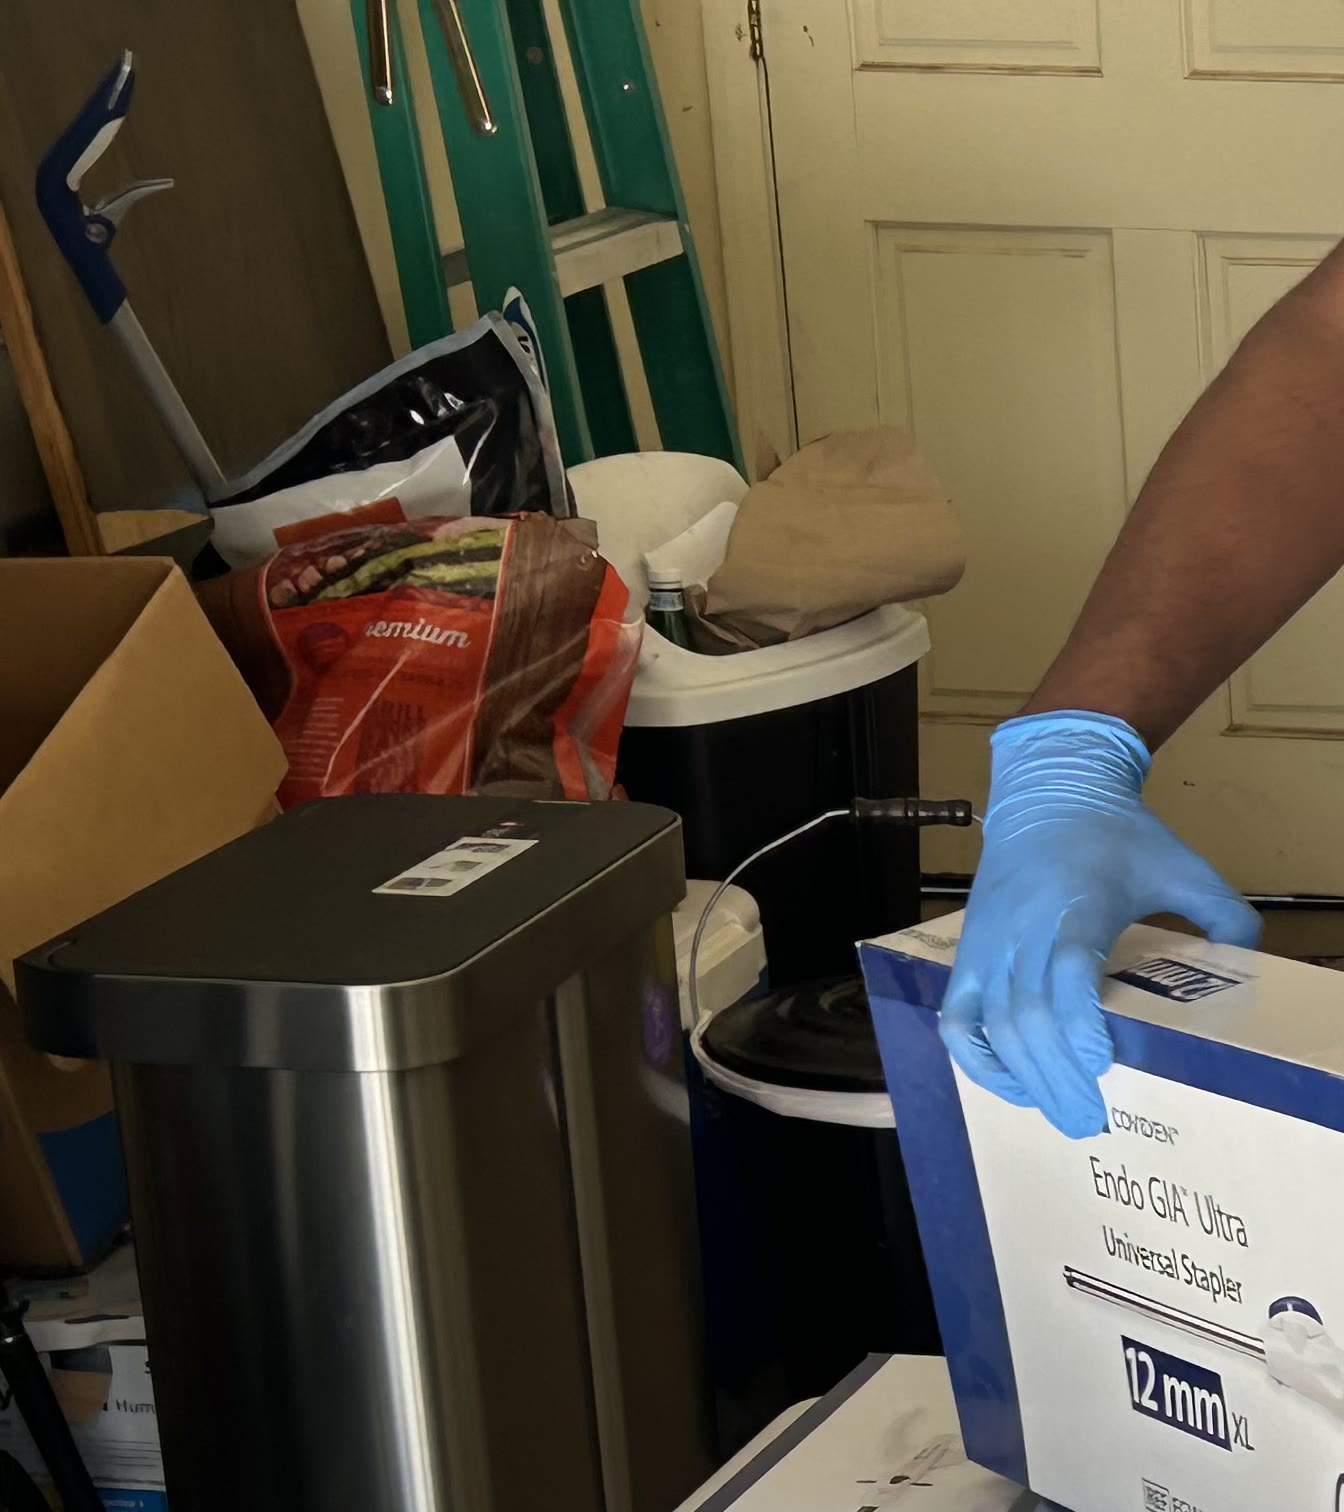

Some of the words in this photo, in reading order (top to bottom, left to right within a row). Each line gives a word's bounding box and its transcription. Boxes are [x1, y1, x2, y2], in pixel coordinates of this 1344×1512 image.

[365, 617, 472, 649] emium
[1089, 1155, 1144, 1210] Endo
[1194, 1191, 1249, 1248] Ultra
[1102, 1225, 1180, 1280] Universal
[1181, 1253, 1243, 1304] Stapler
[1125, 1347, 1159, 1412] 12
[1163, 1373, 1226, 1440] mm
[1232, 1412, 1256, 1451] XL
